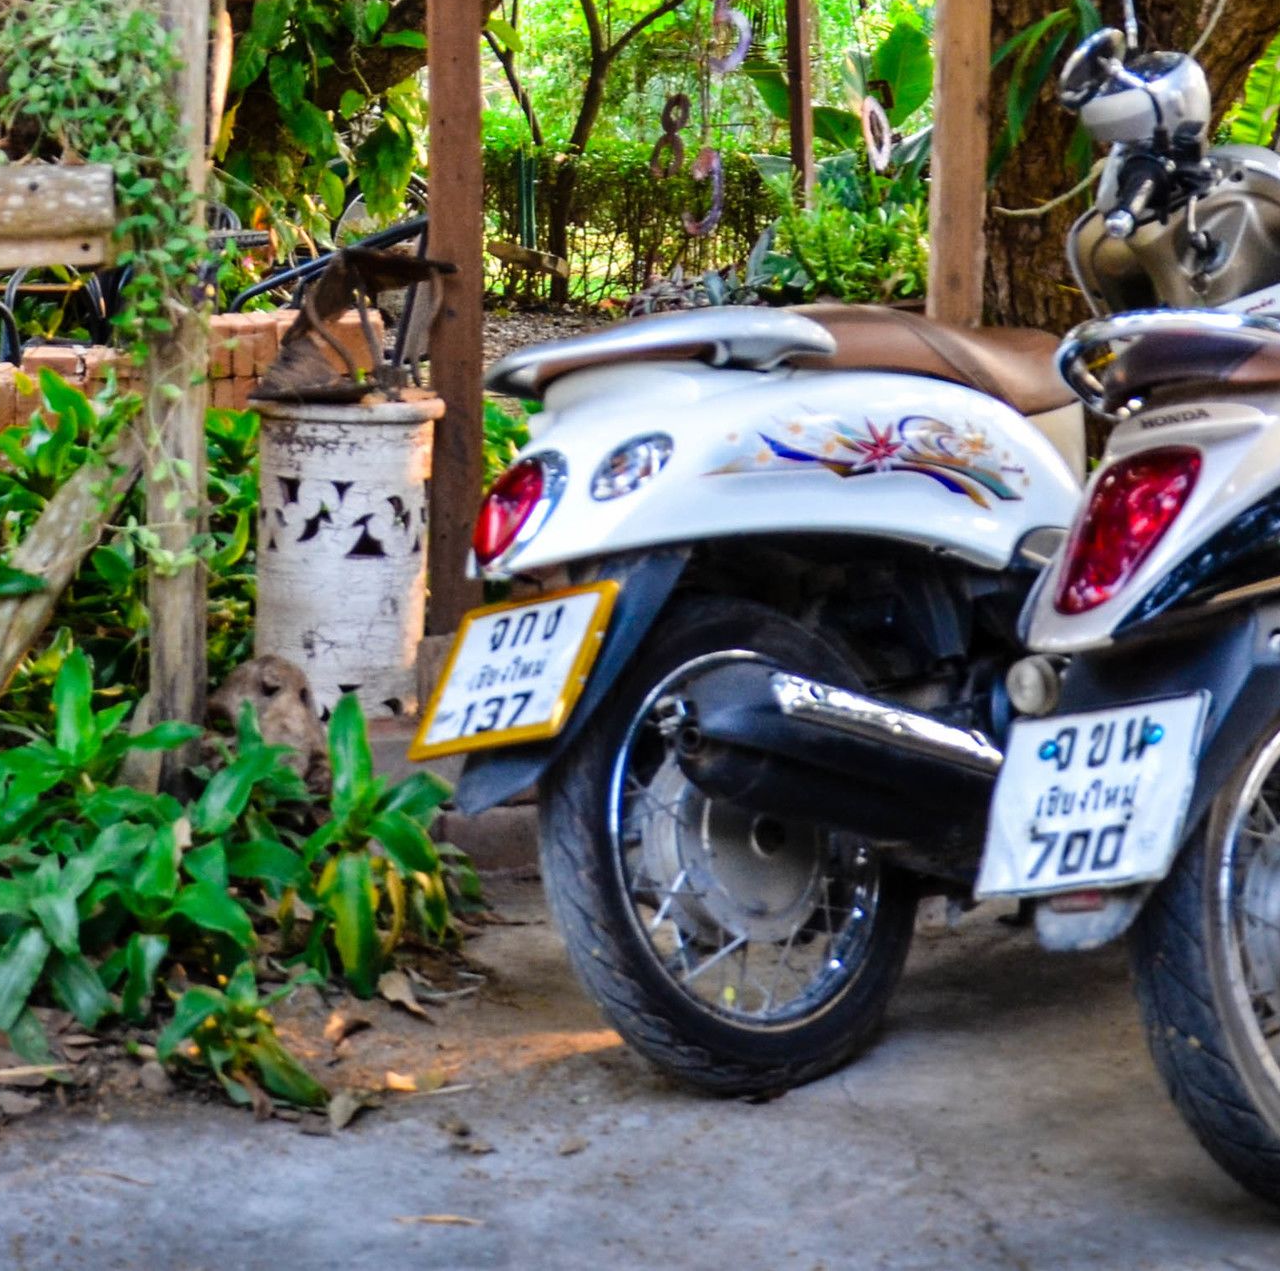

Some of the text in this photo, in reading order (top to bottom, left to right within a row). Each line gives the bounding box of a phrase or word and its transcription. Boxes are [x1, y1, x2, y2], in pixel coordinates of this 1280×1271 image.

[459, 689, 535, 737] 137
[1036, 775, 1140, 818] เชียงใหม่
[1028, 825, 1126, 880] 700
